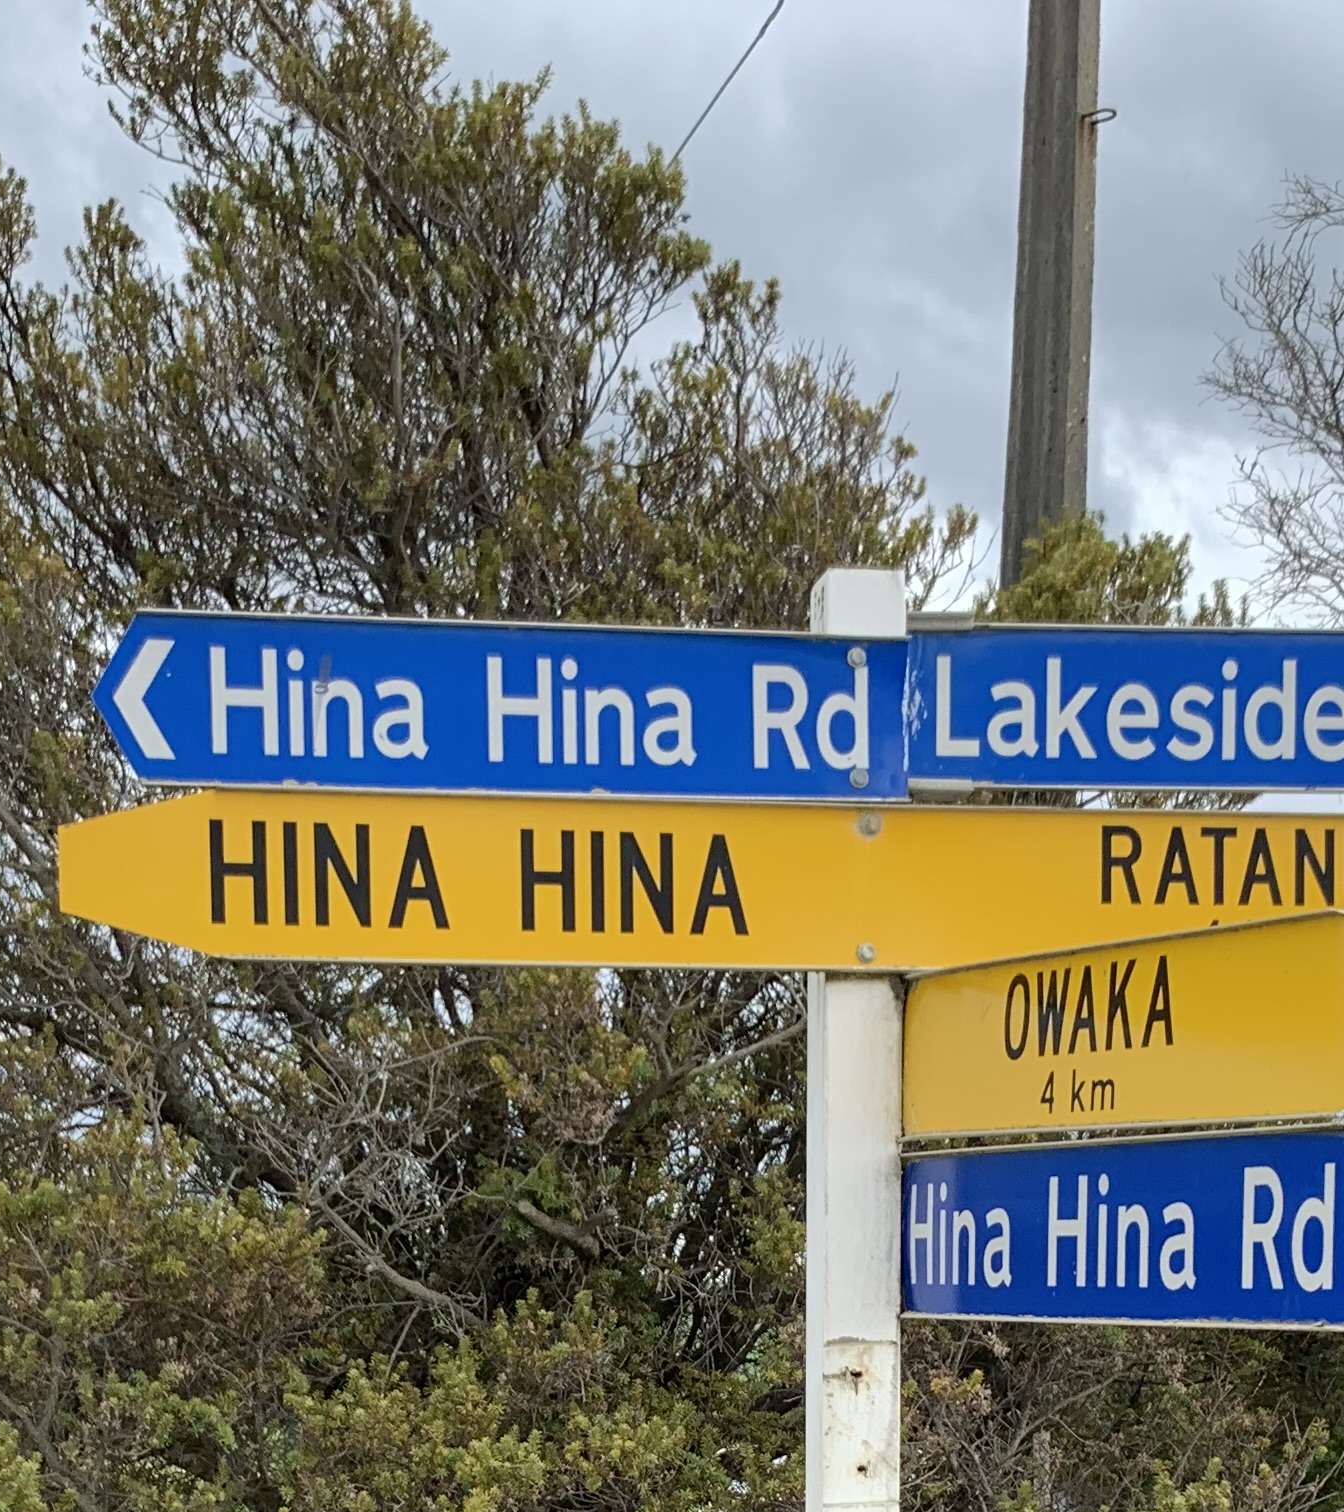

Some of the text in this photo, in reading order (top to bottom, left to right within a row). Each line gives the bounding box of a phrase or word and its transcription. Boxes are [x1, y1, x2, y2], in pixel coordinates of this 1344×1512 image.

[209, 646, 870, 771] Hina Hina Rd
[208, 819, 749, 936] HINA HINA
[1003, 955, 1174, 1061] OWAKA
[1040, 1069, 1116, 1114] 4 km
[909, 1162, 1337, 1292] Hina Hina Rd
